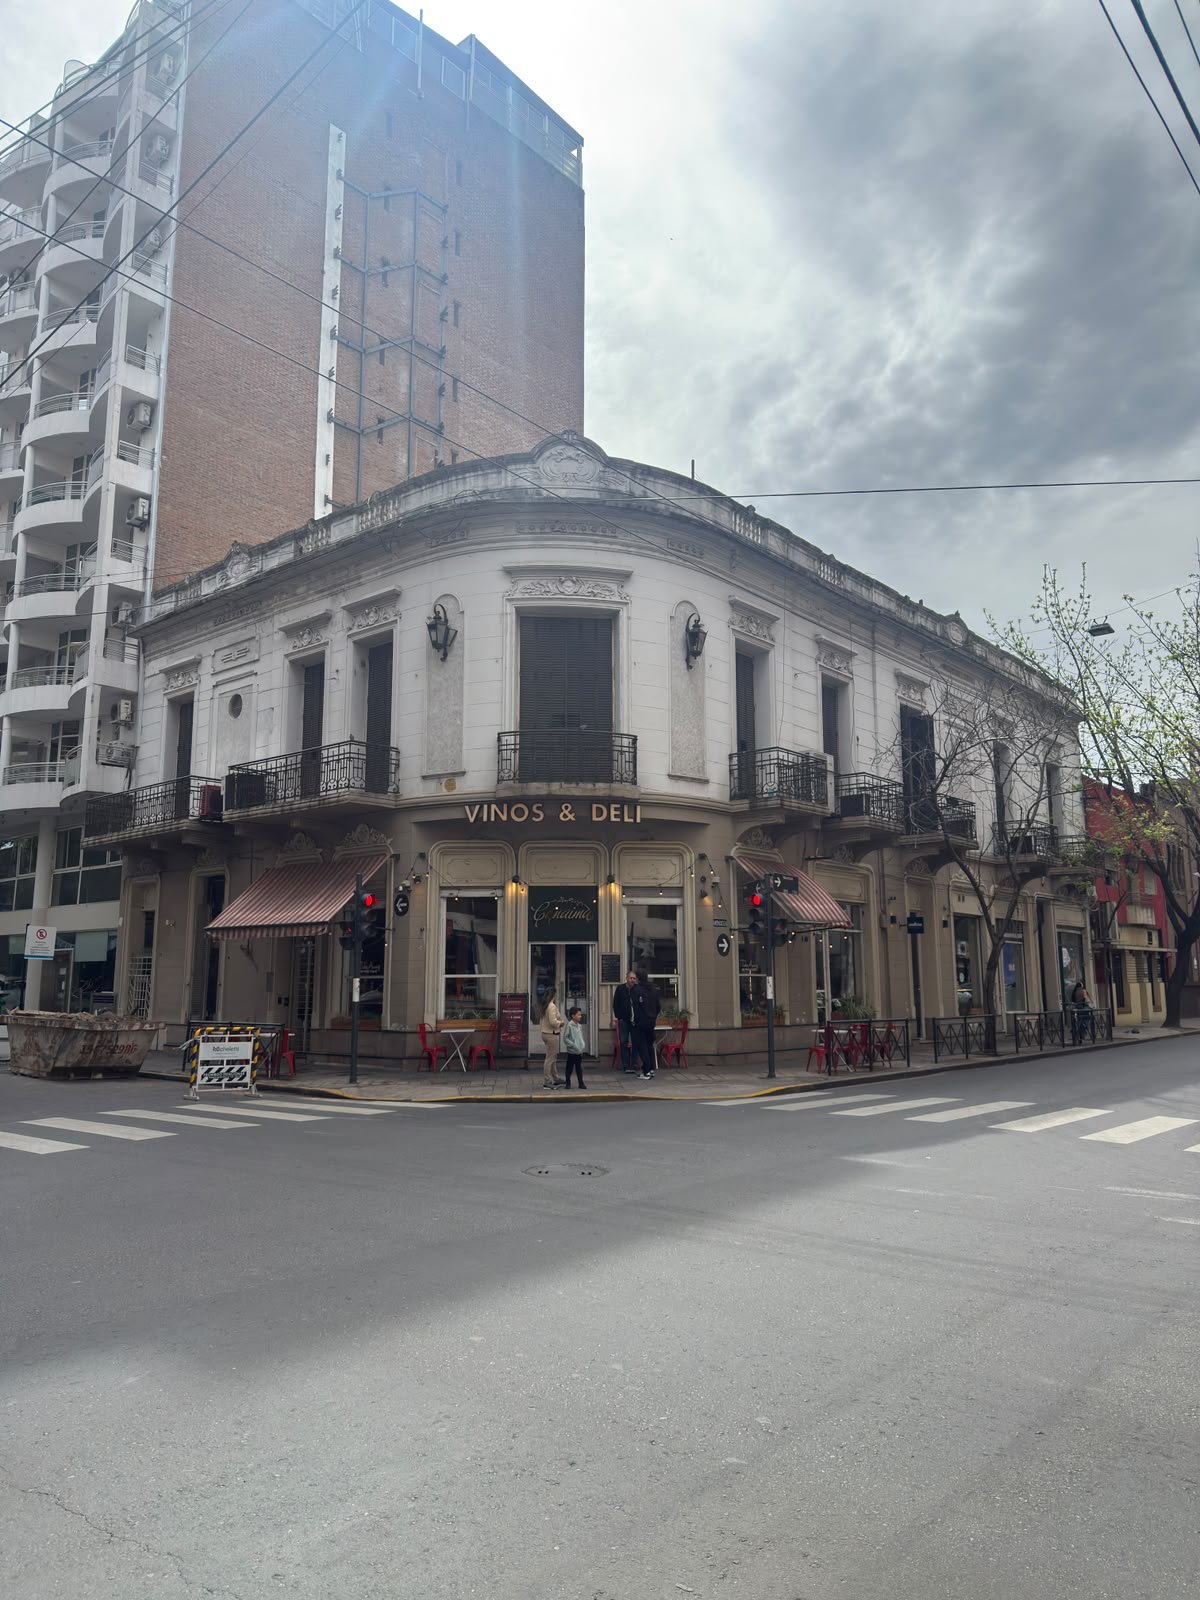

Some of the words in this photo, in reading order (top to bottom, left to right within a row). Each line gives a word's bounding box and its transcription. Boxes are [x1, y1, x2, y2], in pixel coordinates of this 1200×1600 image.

[464, 803, 545, 823] VINOS
[559, 803, 576, 821] &
[591, 803, 641, 823] DELI
